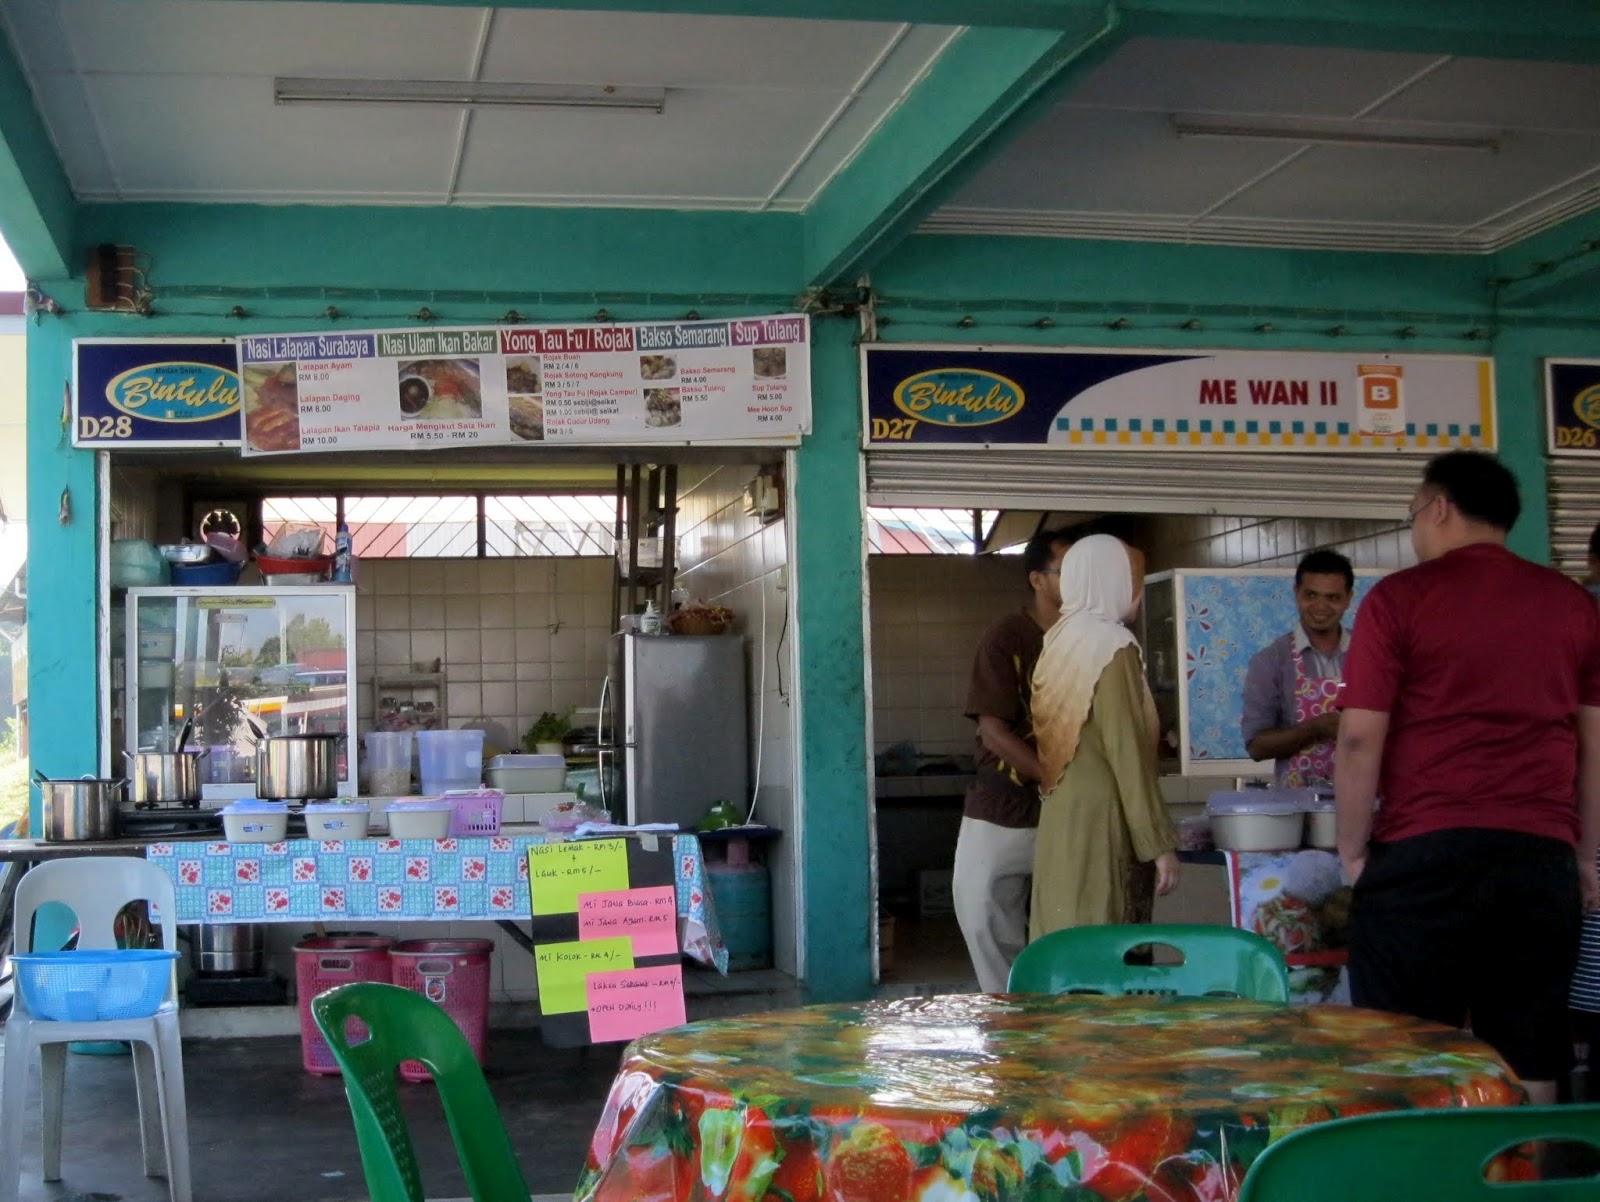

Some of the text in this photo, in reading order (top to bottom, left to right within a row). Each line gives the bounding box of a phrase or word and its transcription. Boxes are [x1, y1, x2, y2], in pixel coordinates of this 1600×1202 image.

[503, 330, 536, 353] Yong
[539, 329, 563, 350] Tau
[566, 329, 583, 349] Fu
[594, 327, 631, 351] Rojak
[640, 325, 727, 348] Bakso Semarang
[735, 319, 800, 345] Sup Tulang
[247, 335, 369, 360] Nasi Lalapan Surabaya
[382, 331, 493, 354] Nasi Ulam Ikan Bakar
[298, 362, 353, 371] Lalapan Ayam
[544, 372, 563, 380] Rojak
[589, 371, 623, 379] Kangkung
[702, 366, 736, 374] Semarang
[122, 374, 240, 410] Bintulu
[587, 389, 608, 397] (Rojak
[609, 388, 638, 396] Campur)
[752, 383, 788, 392] Sup Tulang
[908, 382, 1015, 412] Bintulu
[1199, 379, 1237, 405] ME
[1248, 379, 1309, 405] WAN
[1371, 385, 1391, 401] B
[300, 393, 360, 403] Lalapan Daging
[79, 416, 133, 438] D28
[301, 424, 380, 435] Lalapan Ikan Talapia
[416, 423, 455, 431] Mengikut
[477, 421, 496, 429] Ikan
[546, 418, 565, 426] Rojak
[588, 417, 610, 425] Udang
[872, 418, 919, 440] D27
[317, 436, 337, 444] 10.00
[1556, 426, 1597, 448] D26
